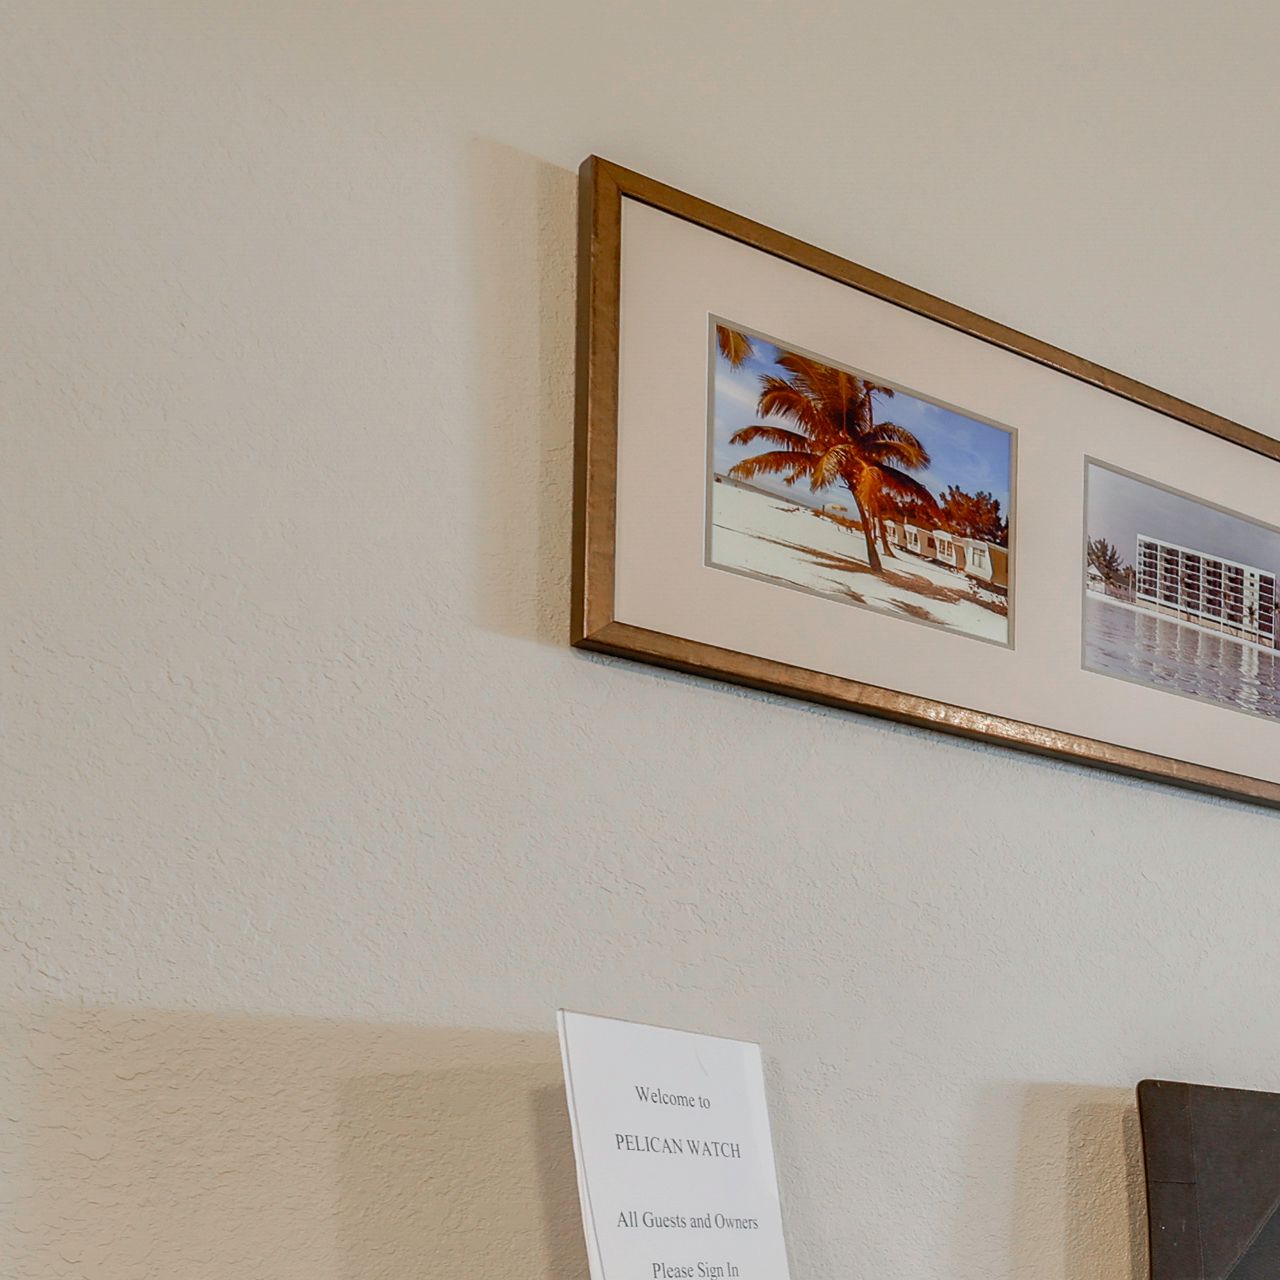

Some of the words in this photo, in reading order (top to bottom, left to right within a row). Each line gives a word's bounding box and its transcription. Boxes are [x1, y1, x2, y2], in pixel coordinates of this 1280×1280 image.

[635, 1085, 696, 1108] Welcome
[698, 1096, 711, 1109] to
[615, 1133, 684, 1154] PELICAN
[686, 1139, 741, 1159] WATCH
[617, 1211, 638, 1228] All
[642, 1211, 687, 1228] Guests
[690, 1213, 712, 1229] and
[714, 1213, 759, 1229] Owners
[652, 1262, 694, 1279] Please
[727, 1262, 740, 1278] In
